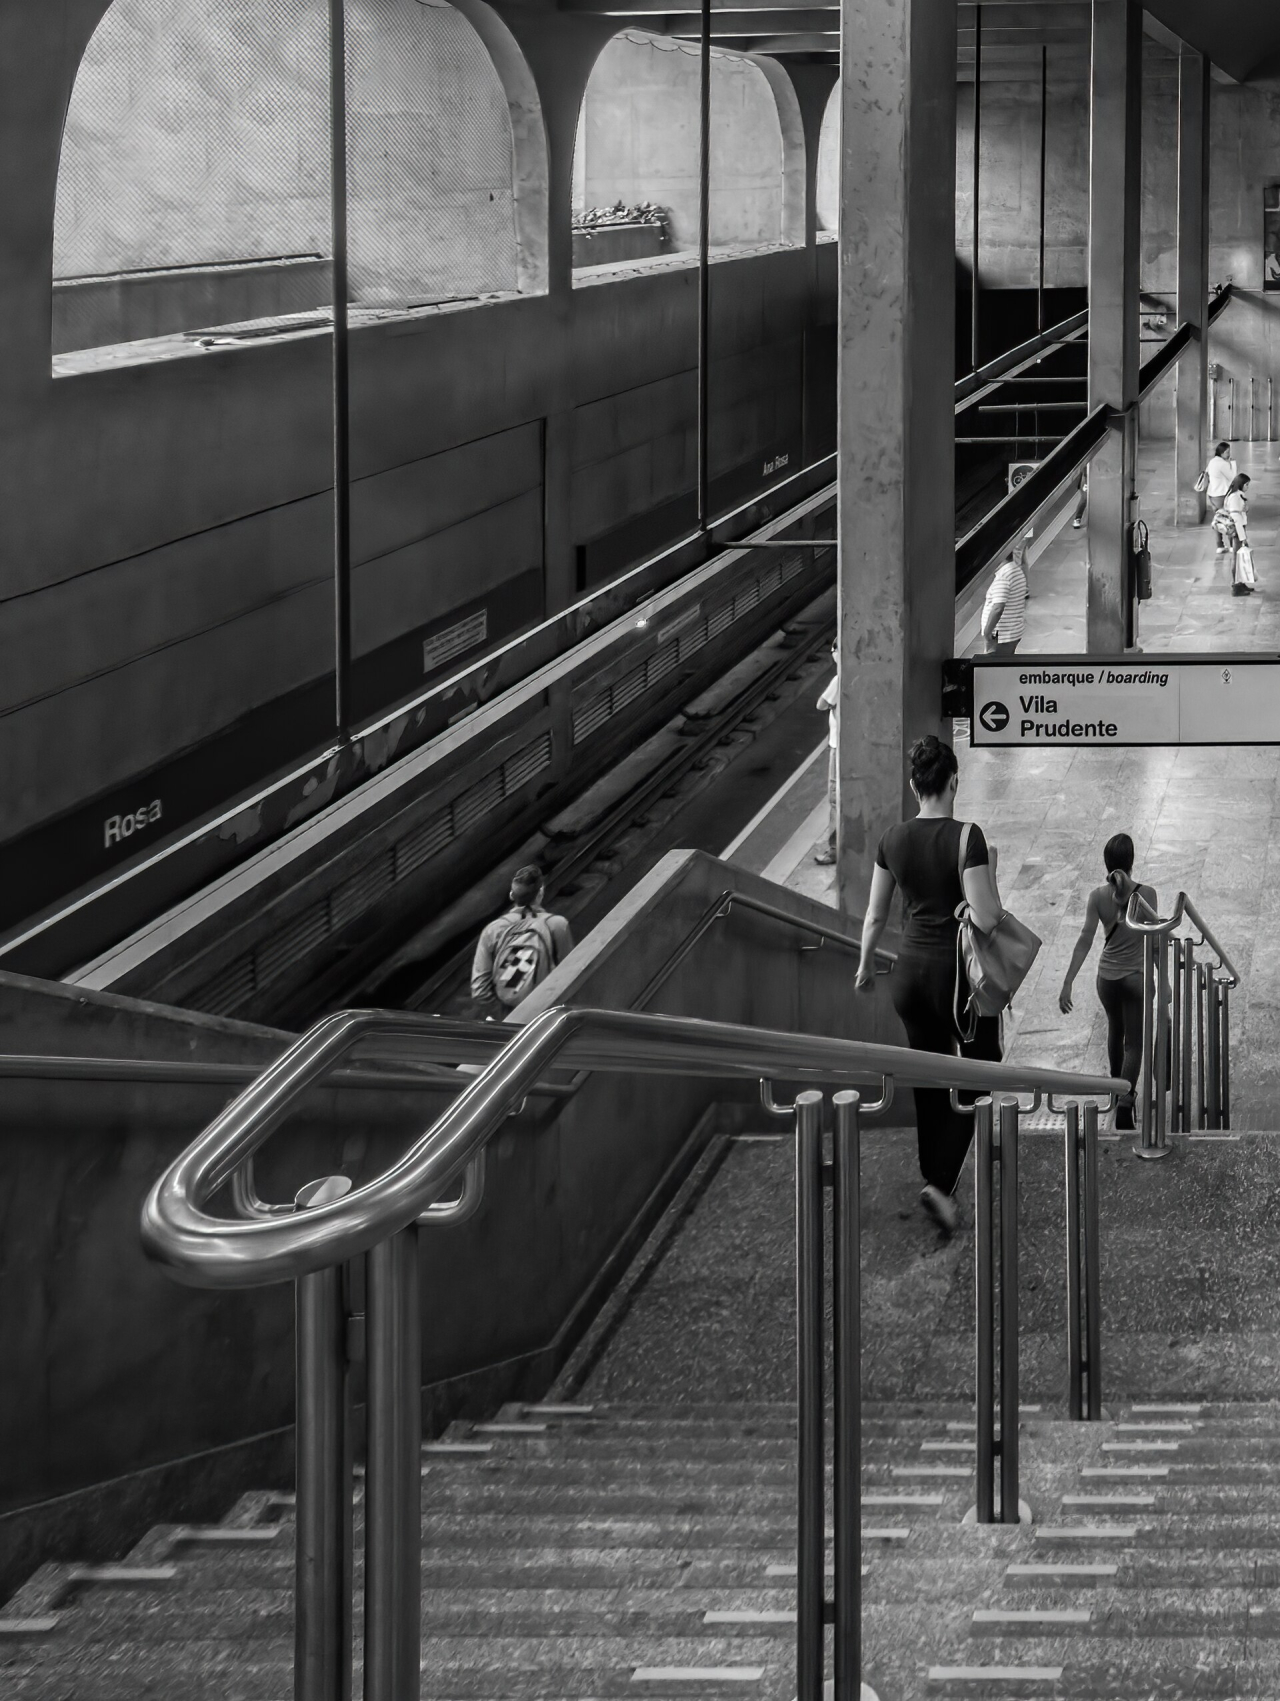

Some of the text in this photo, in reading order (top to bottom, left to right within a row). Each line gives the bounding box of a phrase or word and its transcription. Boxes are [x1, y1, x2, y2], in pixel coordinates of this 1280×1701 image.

[1019, 695, 1058, 714] Vila
[1020, 719, 1118, 737] Prudente
[103, 798, 163, 849] Rosa
